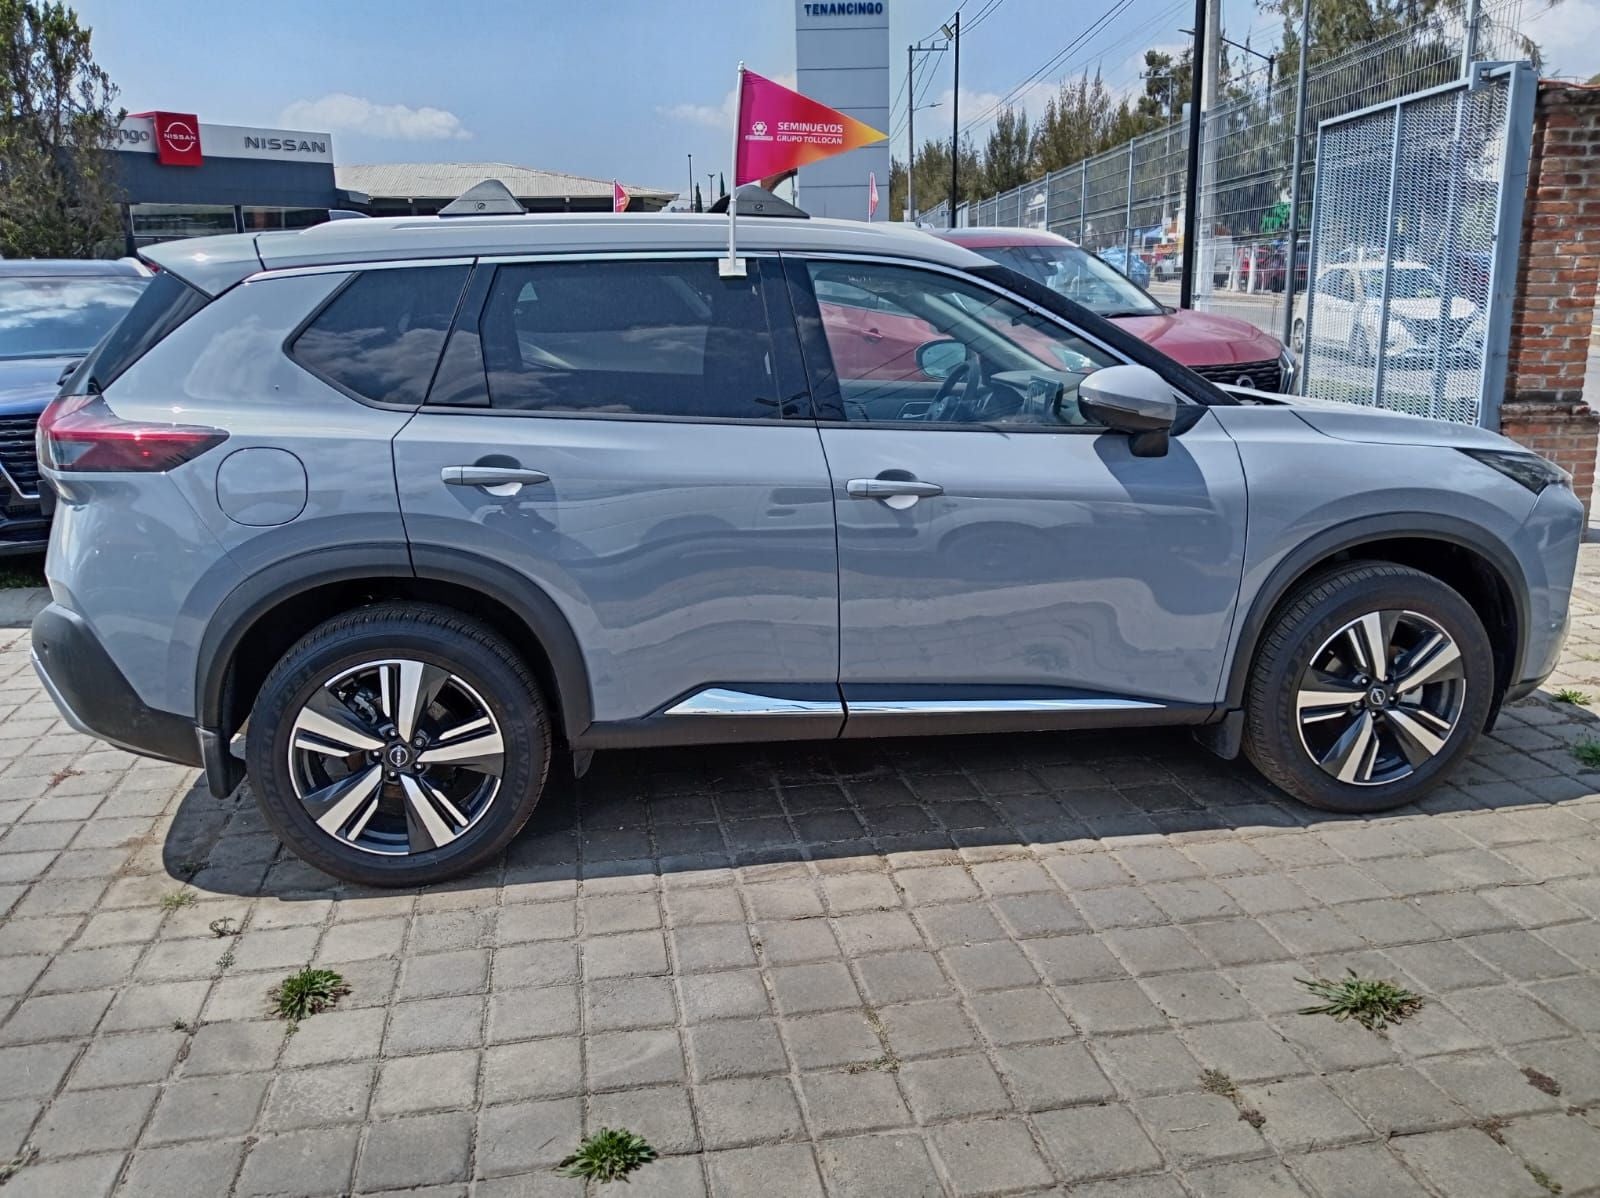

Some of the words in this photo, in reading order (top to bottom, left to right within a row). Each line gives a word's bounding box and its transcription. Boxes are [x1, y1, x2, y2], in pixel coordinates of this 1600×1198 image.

[804, 2, 883, 16] TENANCINGO
[777, 122, 843, 133] SEMINUEVOS
[164, 133, 196, 141] NISSAN
[777, 135, 802, 143] GRUPO
[804, 136, 842, 145] TOLLOCAN
[244, 136, 325, 153] NISSAN
